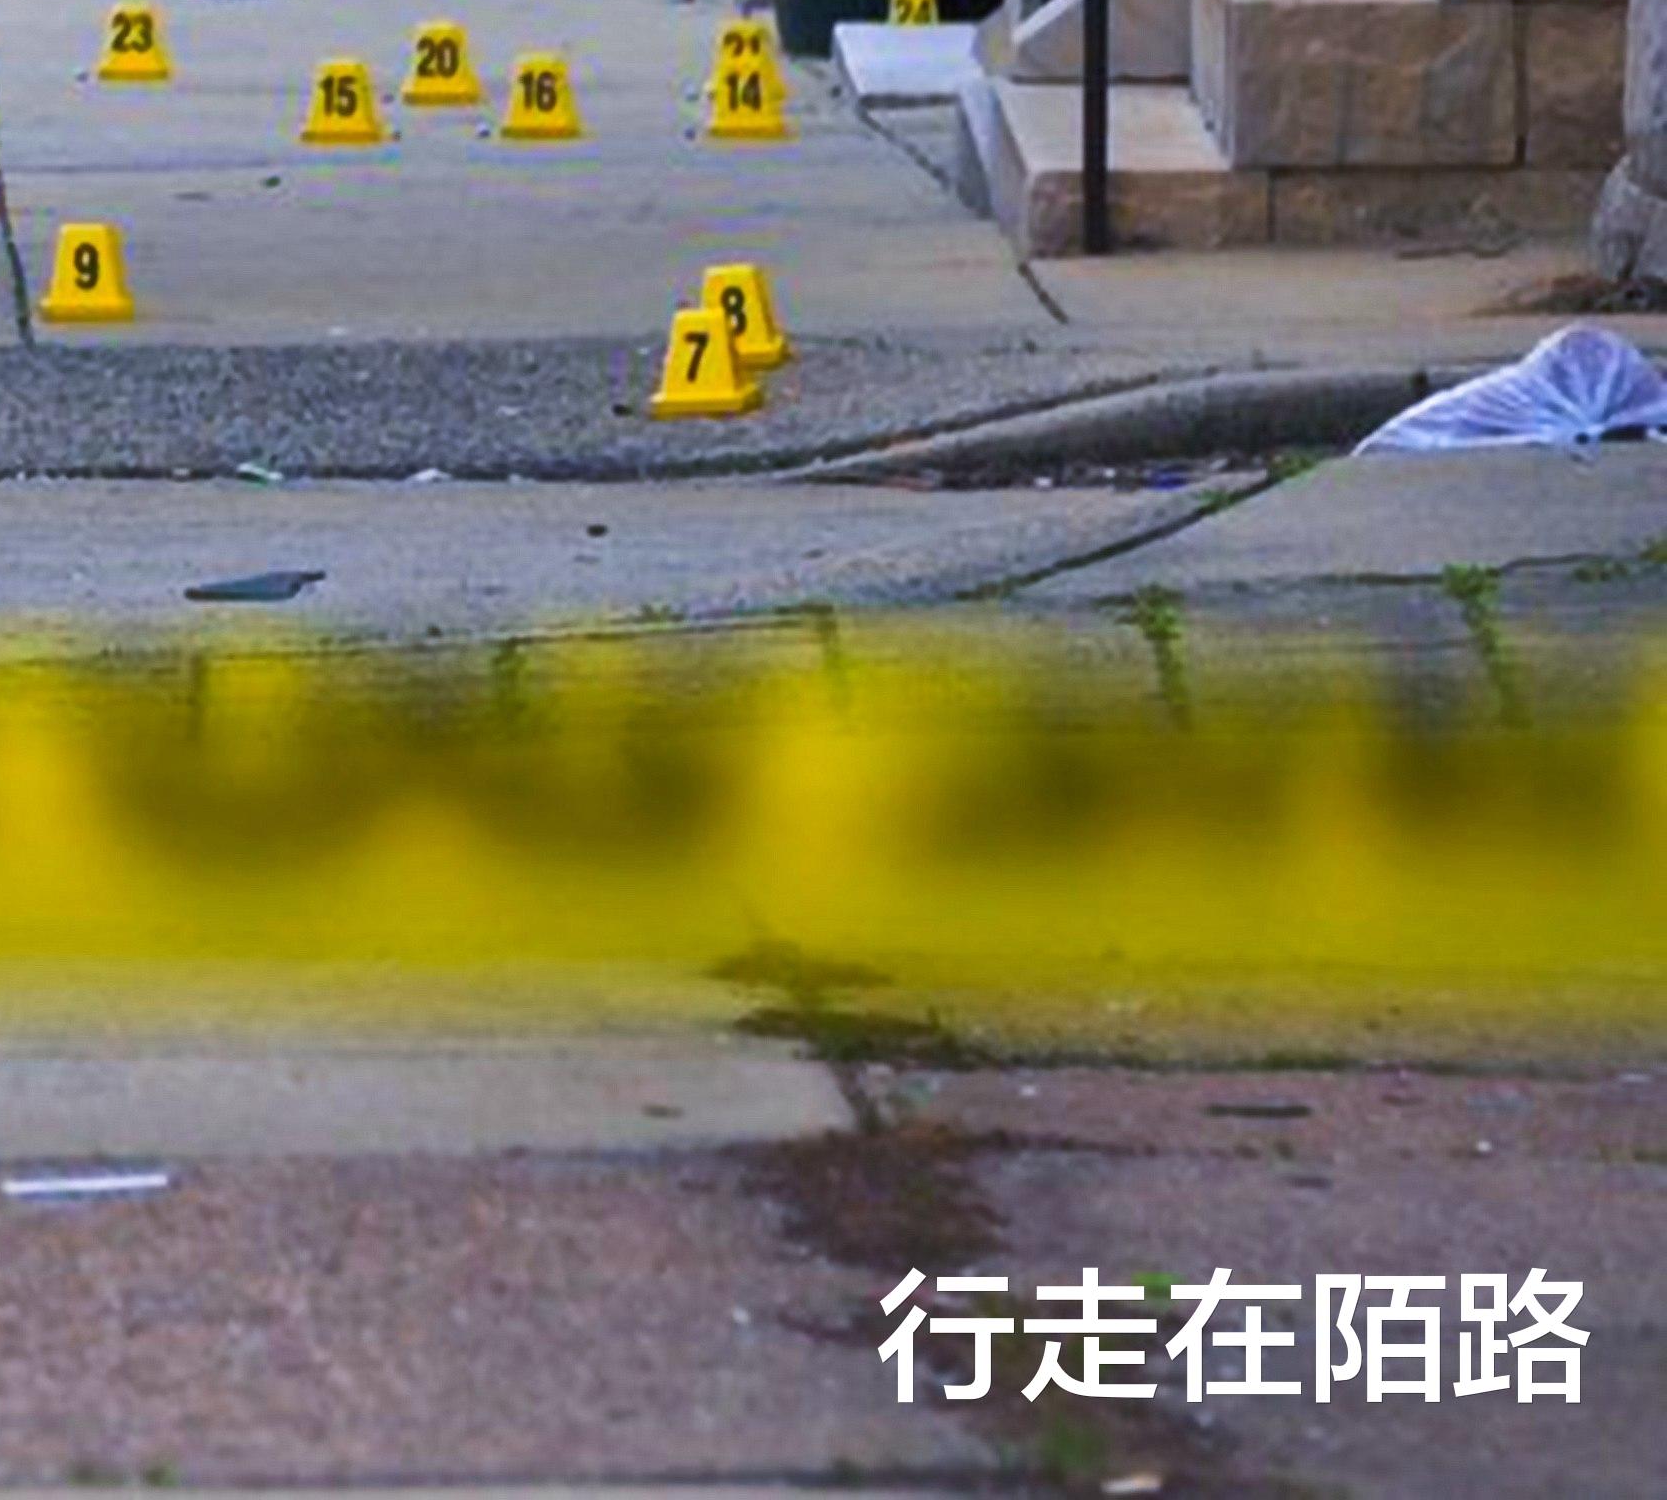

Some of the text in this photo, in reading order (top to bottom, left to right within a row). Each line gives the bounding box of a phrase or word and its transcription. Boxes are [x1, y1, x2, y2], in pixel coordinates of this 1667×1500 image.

[111, 12, 153, 54] 23
[417, 37, 459, 79] 20
[320, 75, 358, 117] 15
[519, 71, 557, 112] 16
[726, 71, 762, 112] 14
[73, 243, 100, 290] 9
[720, 286, 746, 337] 8
[683, 332, 709, 383] 7
